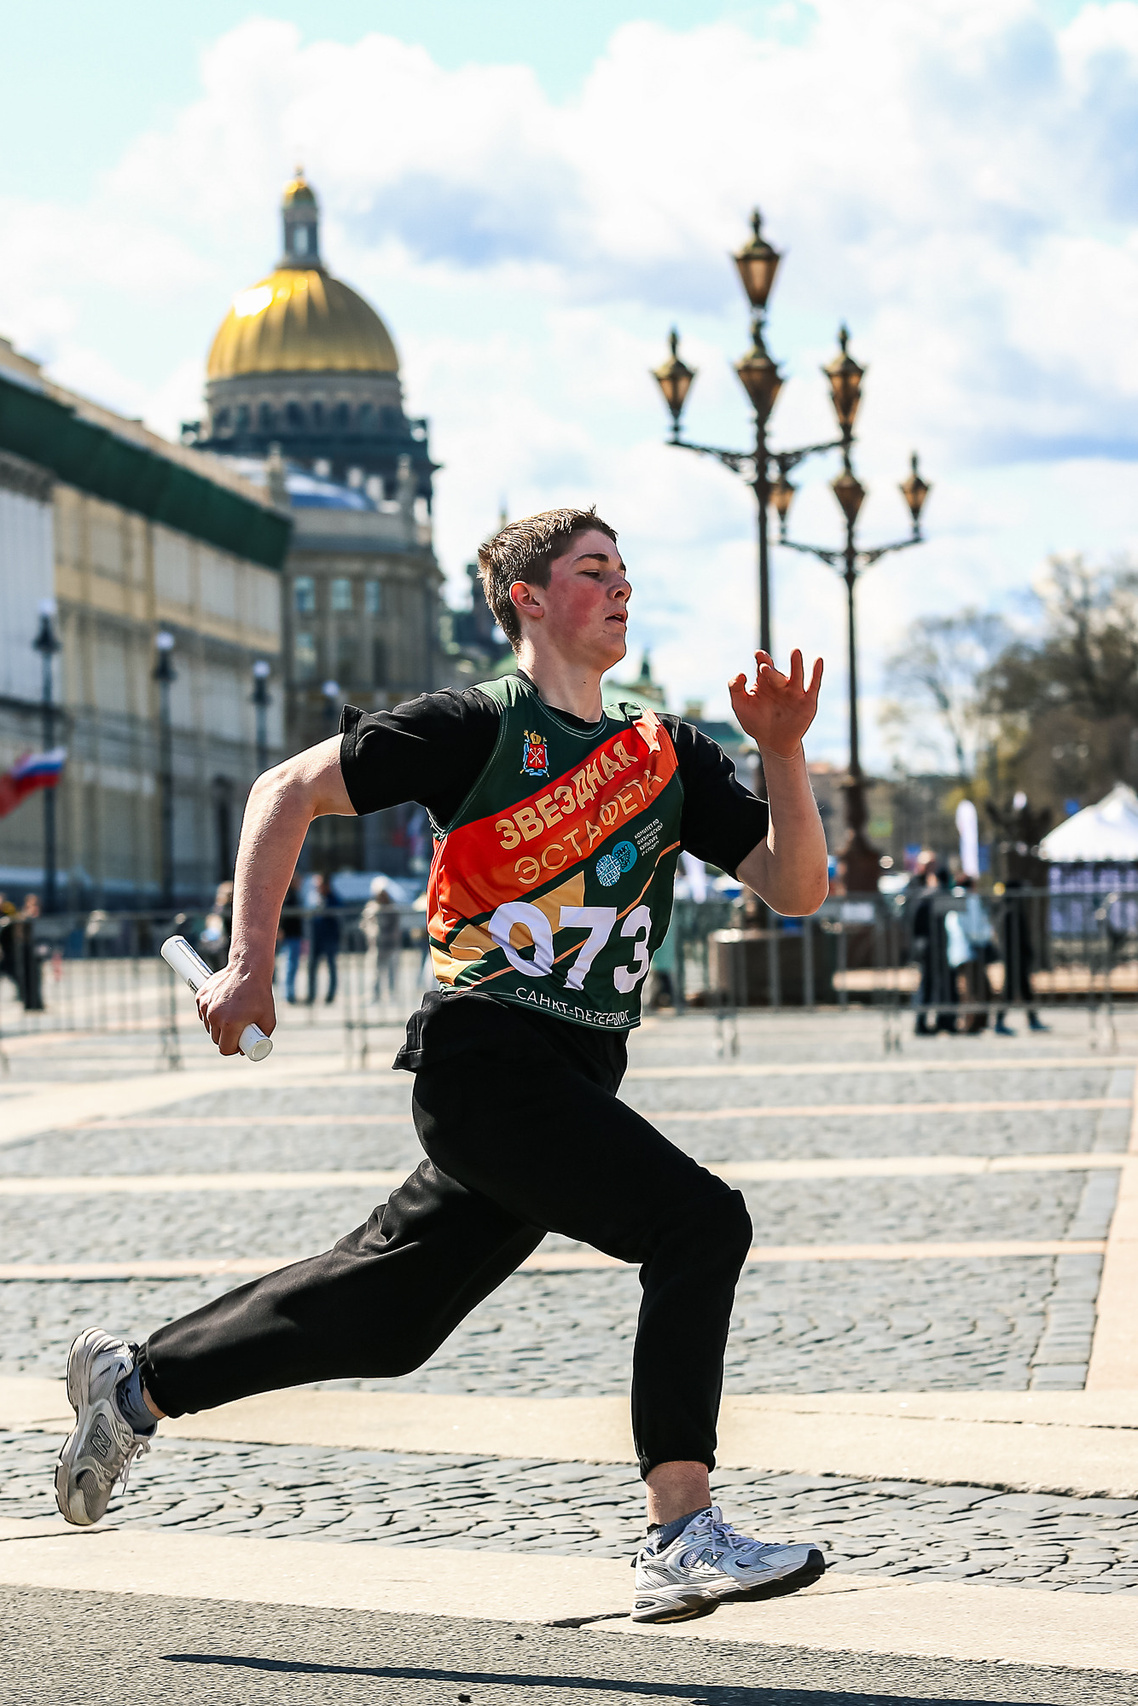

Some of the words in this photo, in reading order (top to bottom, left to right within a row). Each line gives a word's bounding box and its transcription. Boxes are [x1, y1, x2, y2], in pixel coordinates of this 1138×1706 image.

[495, 740, 639, 850] ЗВЕЗДНАЯ
[514, 769, 664, 885] ЭСТАФЕТА
[487, 901, 653, 996] 073
[515, 987, 630, 1026] САНКТ-ПЕТЕРБУРГ
